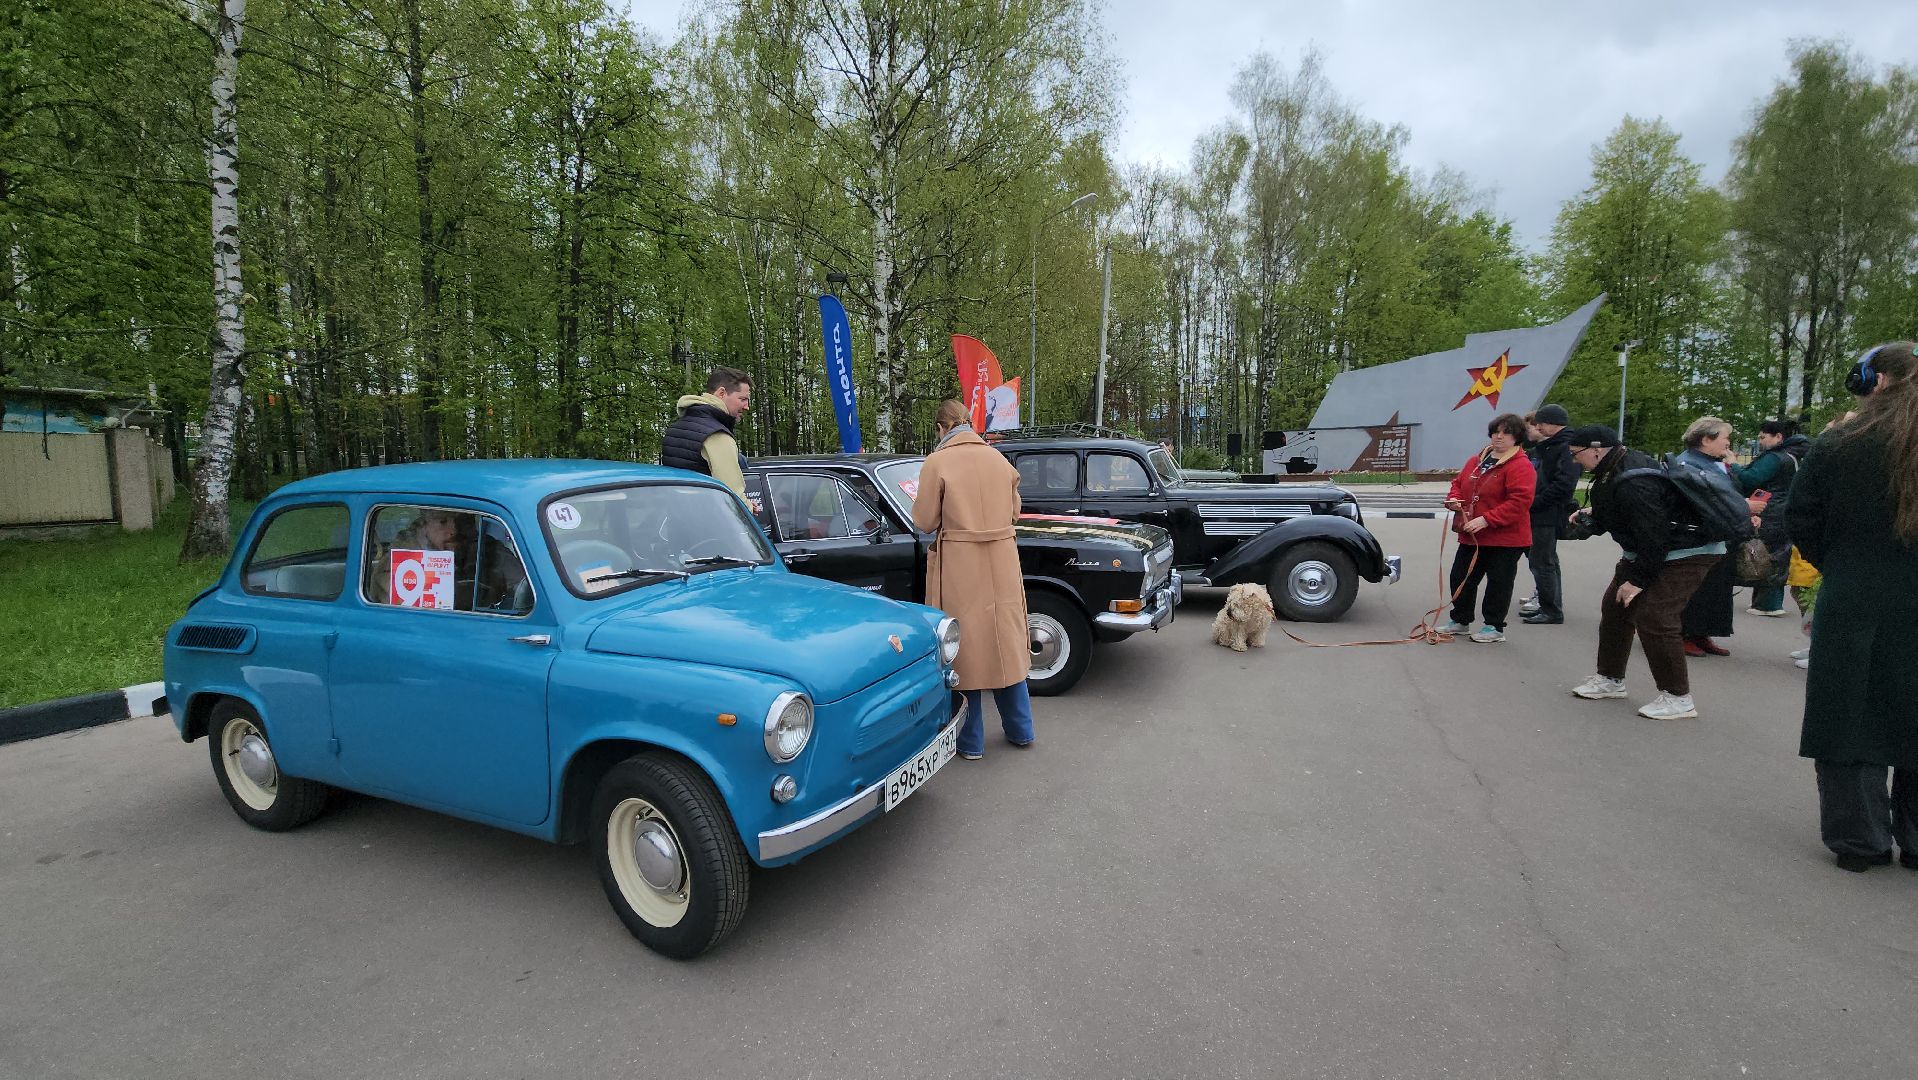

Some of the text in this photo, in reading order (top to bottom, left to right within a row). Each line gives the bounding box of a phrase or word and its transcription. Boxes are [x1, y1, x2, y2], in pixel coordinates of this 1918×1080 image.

[1379, 439, 1406, 447] 1941
[1378, 447, 1406, 456] 1945
[555, 507, 572, 522] 47
